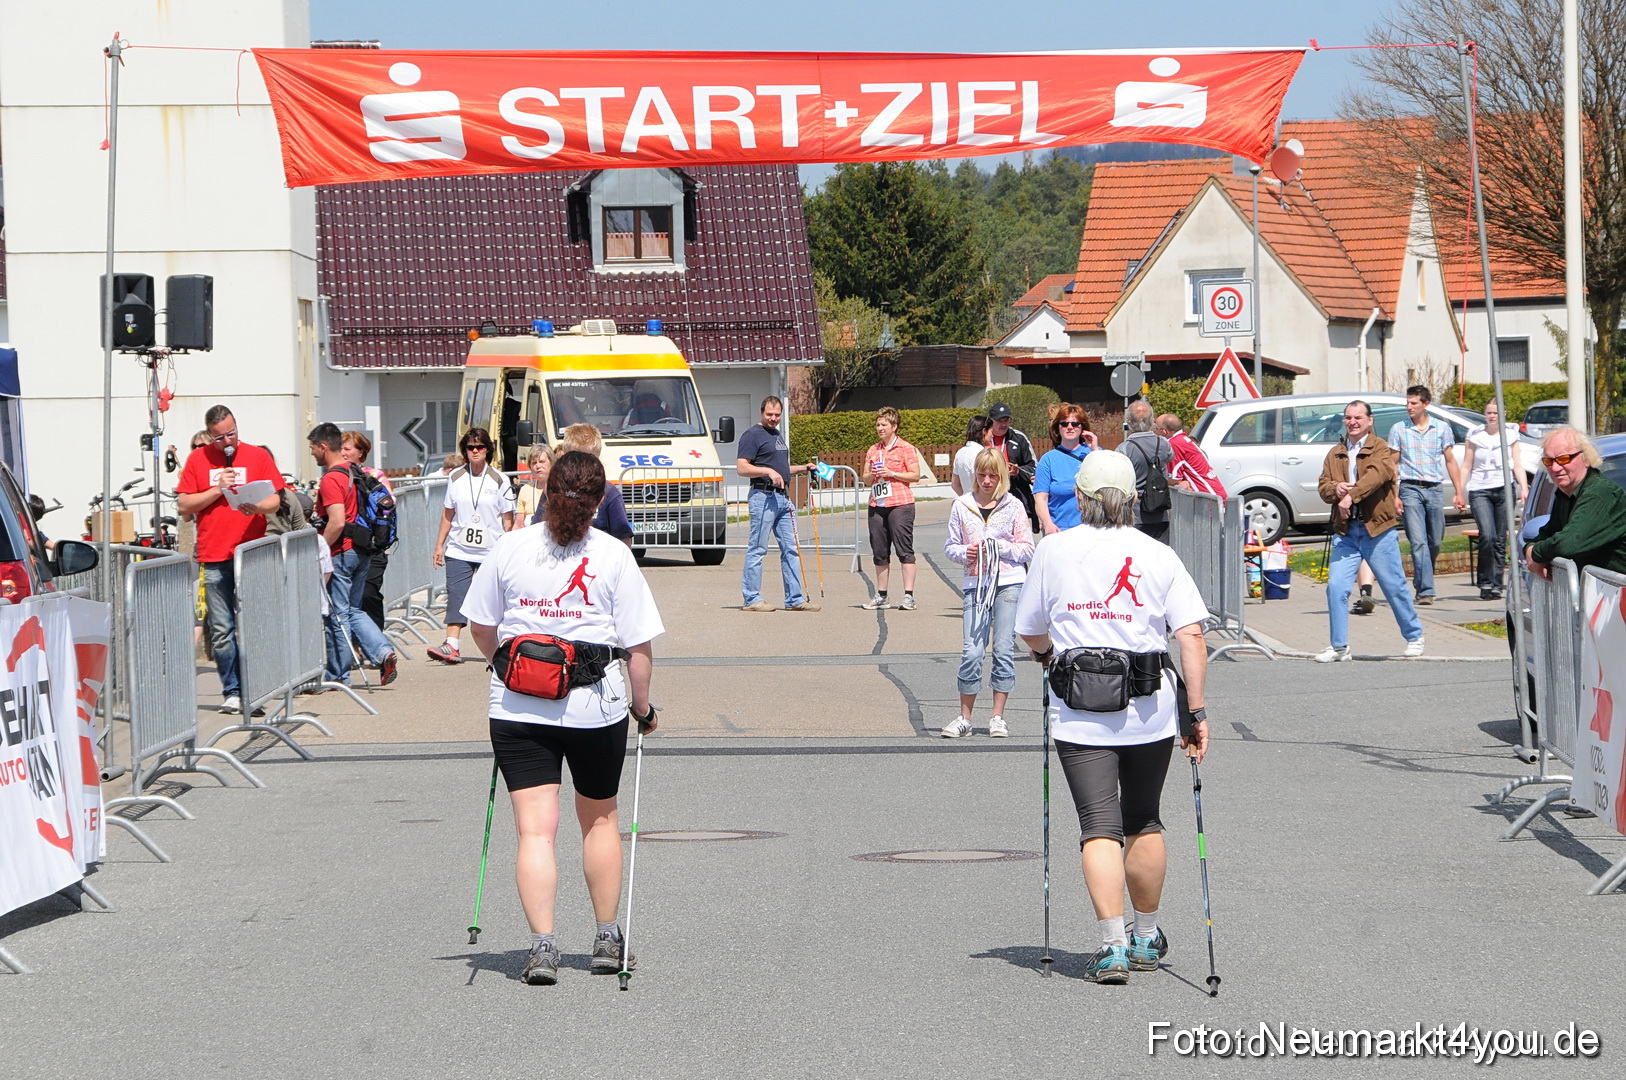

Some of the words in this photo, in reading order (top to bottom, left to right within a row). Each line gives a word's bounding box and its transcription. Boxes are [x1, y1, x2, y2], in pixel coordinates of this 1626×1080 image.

[1217, 296, 1237, 311] 30
[1215, 321, 1240, 330] ZONE
[618, 455, 674, 468] SEG
[873, 482, 889, 498] 105
[465, 527, 483, 545] 85
[519, 598, 553, 608] Nordic
[1066, 601, 1104, 612] Nordic
[539, 608, 583, 619] Walking
[1089, 611, 1133, 623] Walking
